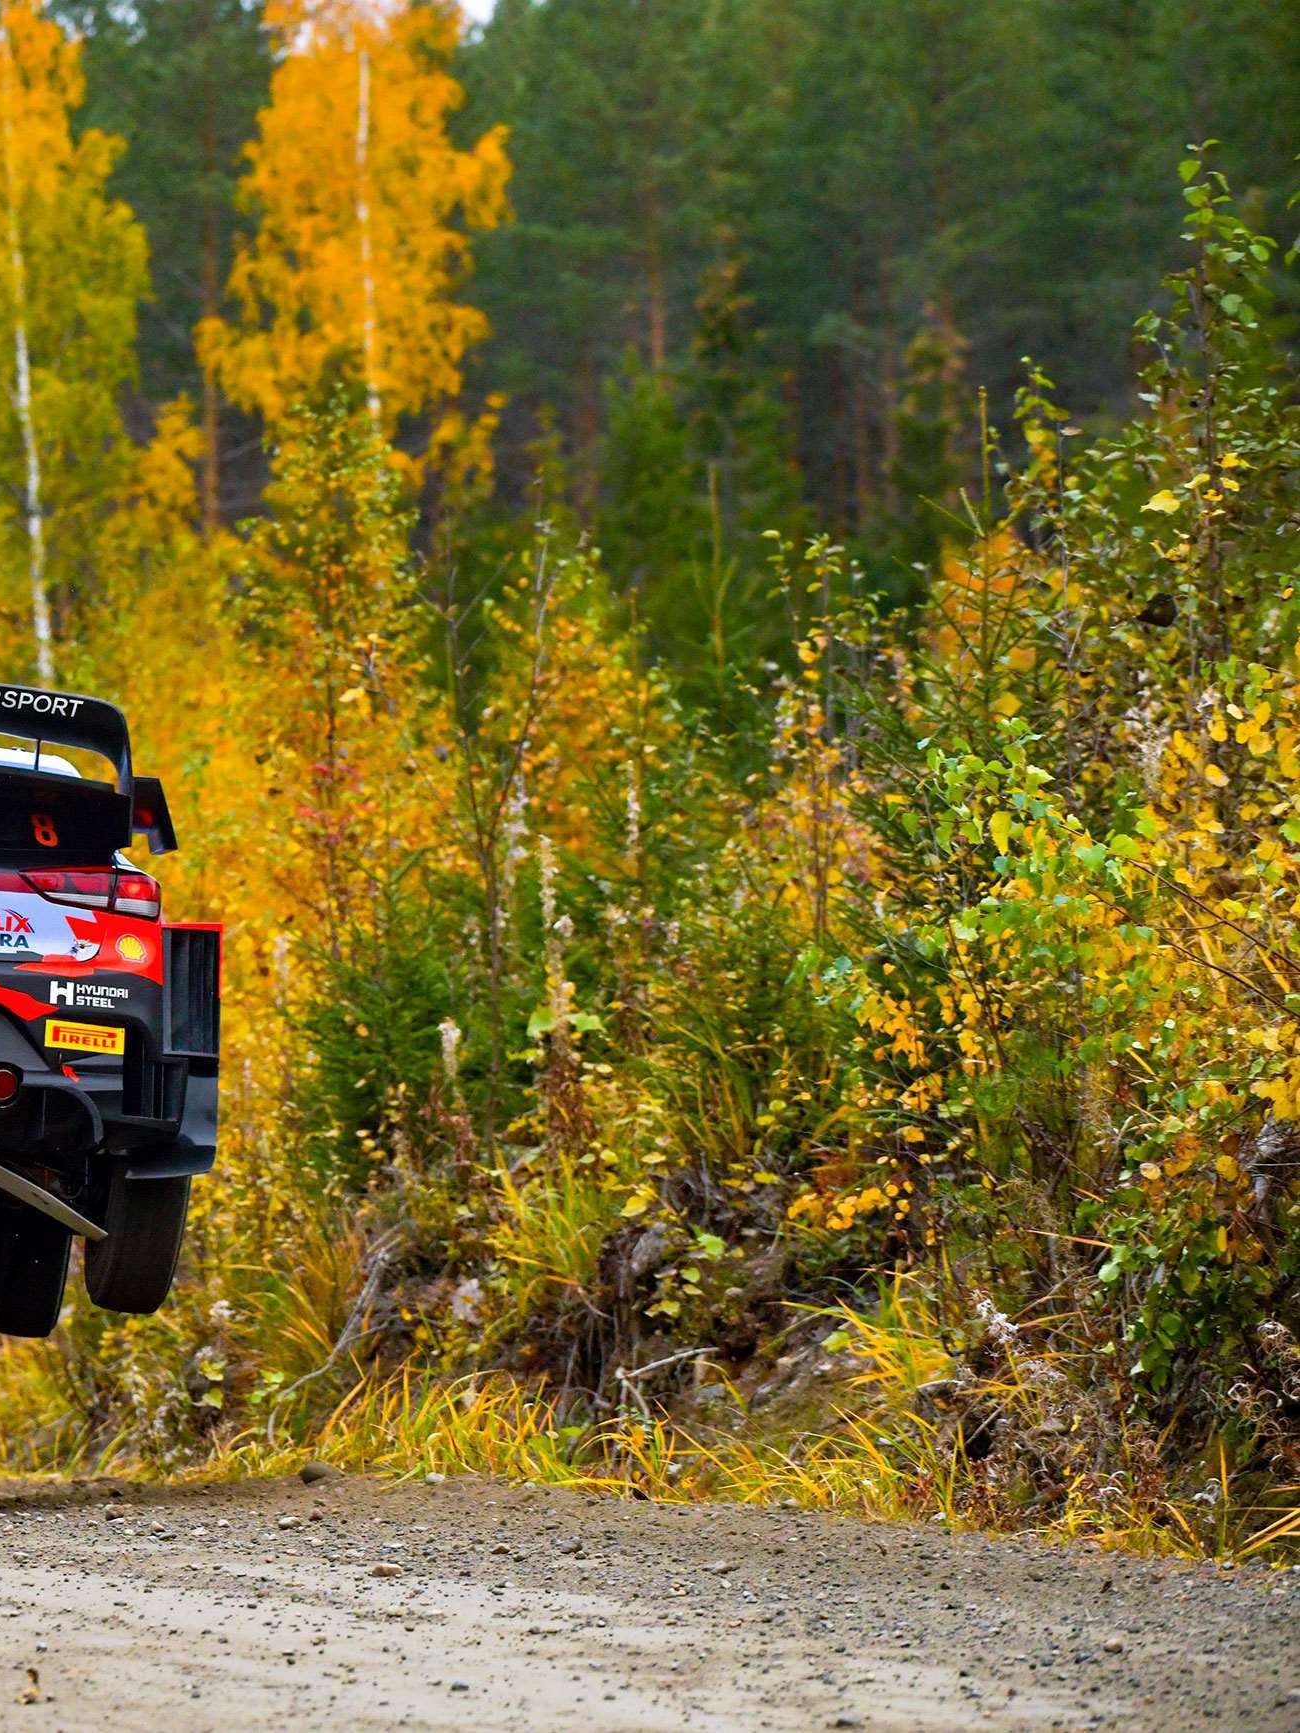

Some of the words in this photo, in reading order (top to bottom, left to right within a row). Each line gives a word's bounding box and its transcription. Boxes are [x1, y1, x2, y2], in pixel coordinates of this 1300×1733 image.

[31, 814, 59, 847] 8
[76, 984, 129, 999] HYUNDAI
[75, 995, 115, 1009] STEEL
[52, 1026, 117, 1049] PIRELLI
